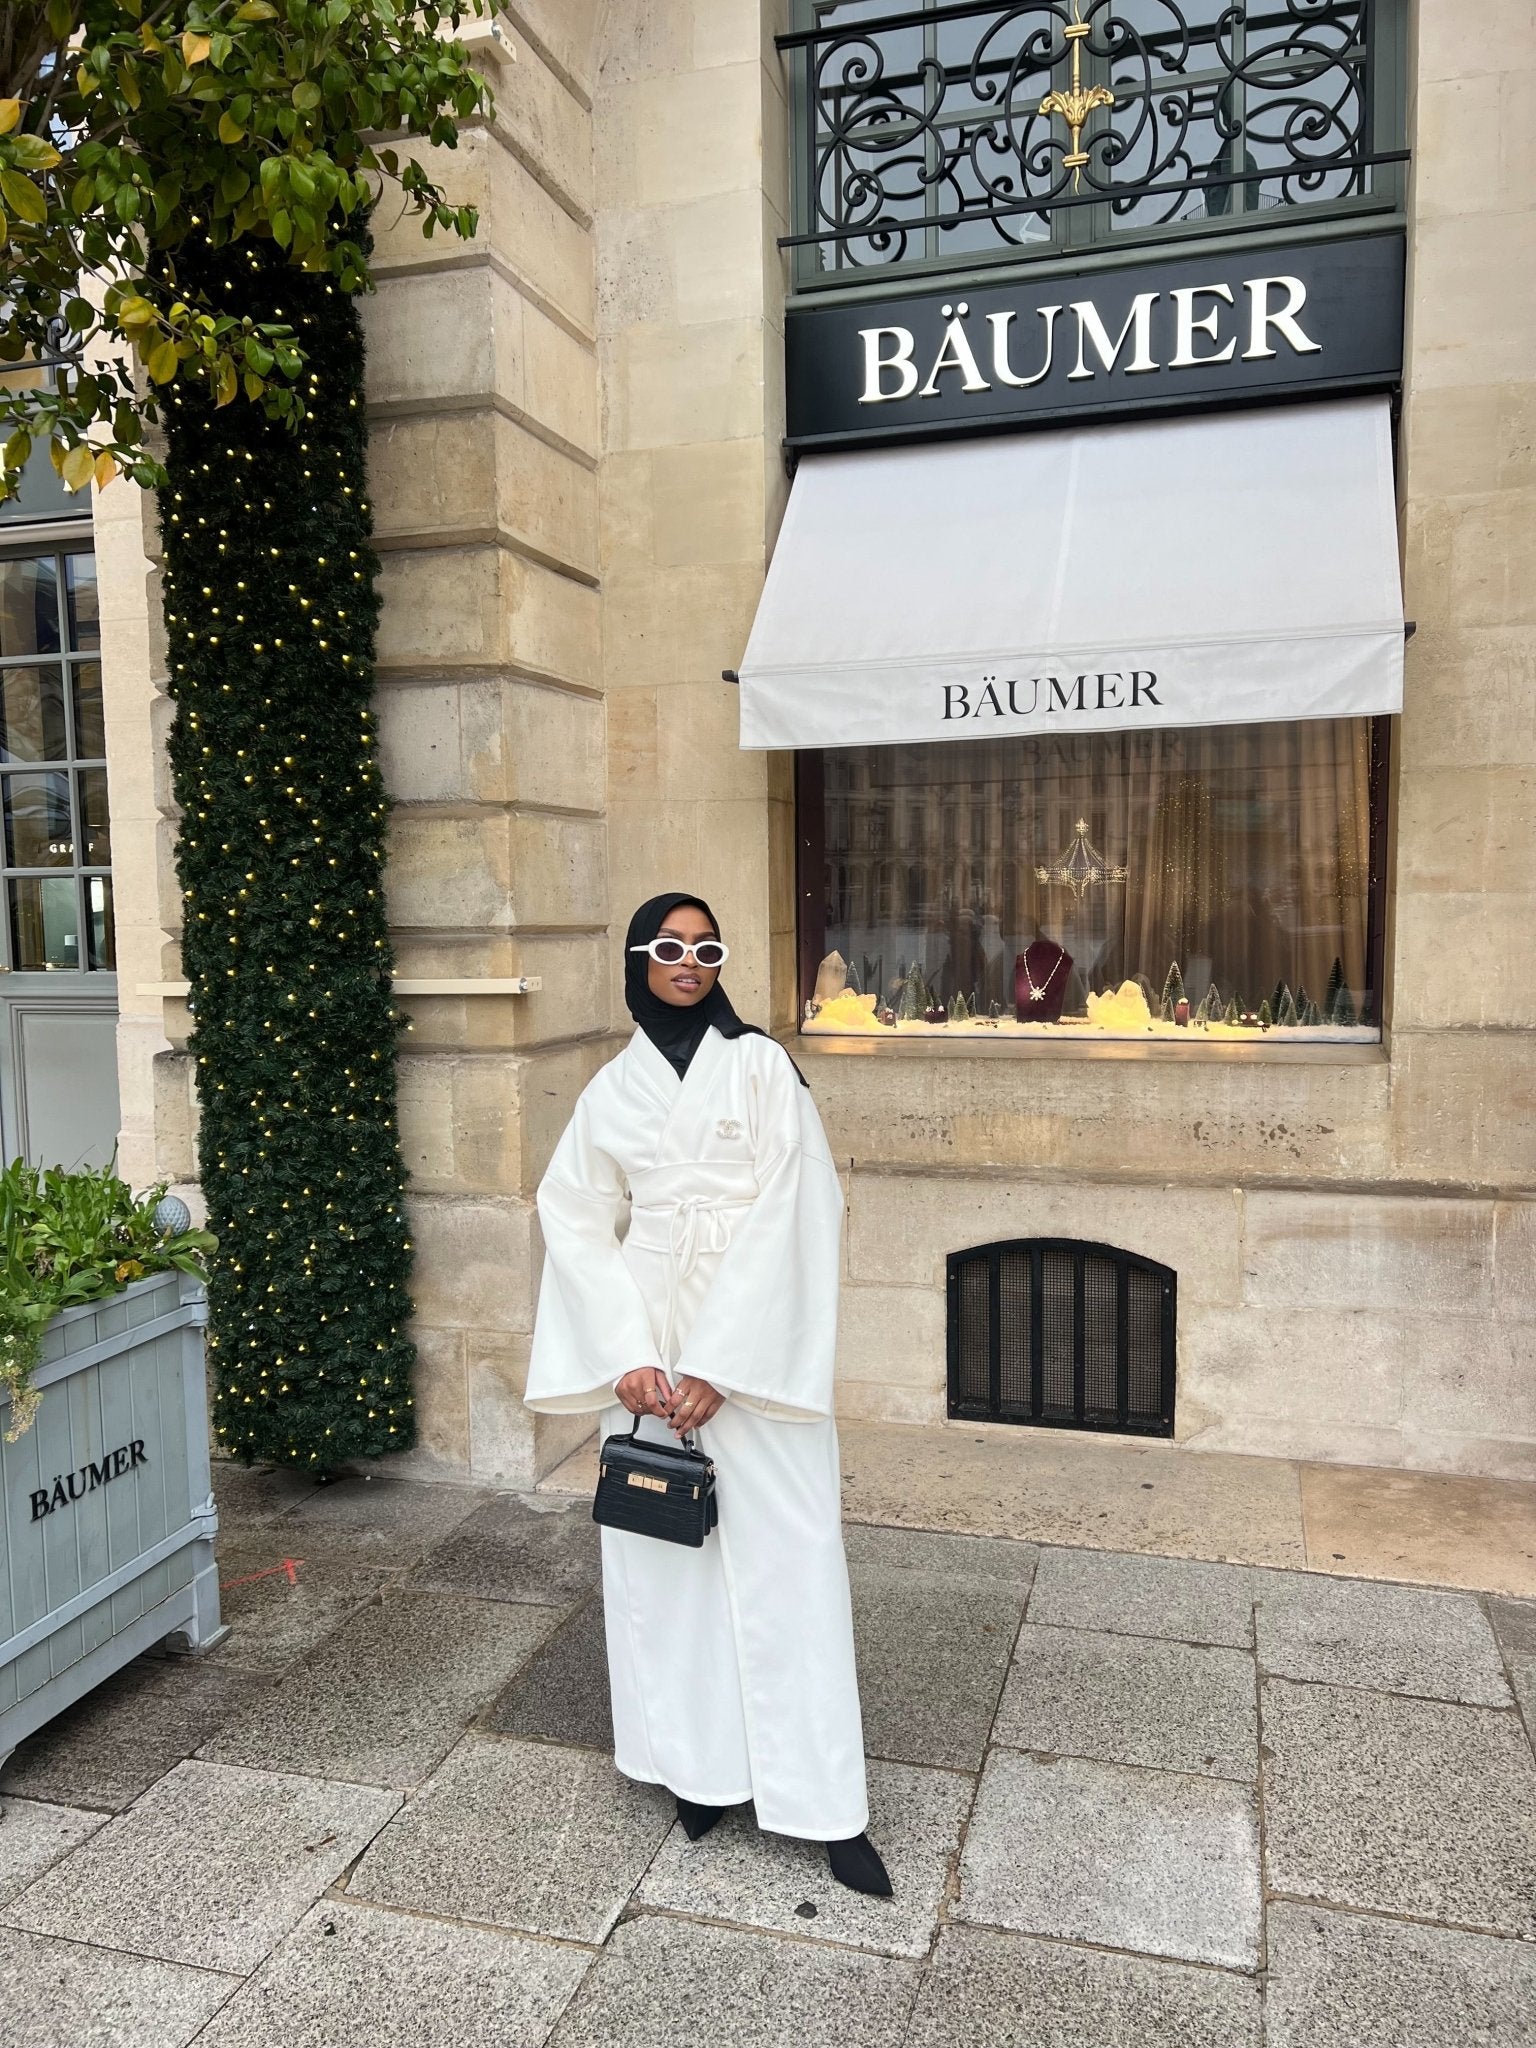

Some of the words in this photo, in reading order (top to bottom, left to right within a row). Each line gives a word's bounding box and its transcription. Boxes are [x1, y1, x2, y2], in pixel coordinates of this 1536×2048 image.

[857, 276, 1323, 404] BÄUMER
[942, 671, 1163, 720] BÄUMER
[49, 842, 94, 854] GRAF
[29, 1439, 149, 1523] BÄUMER
